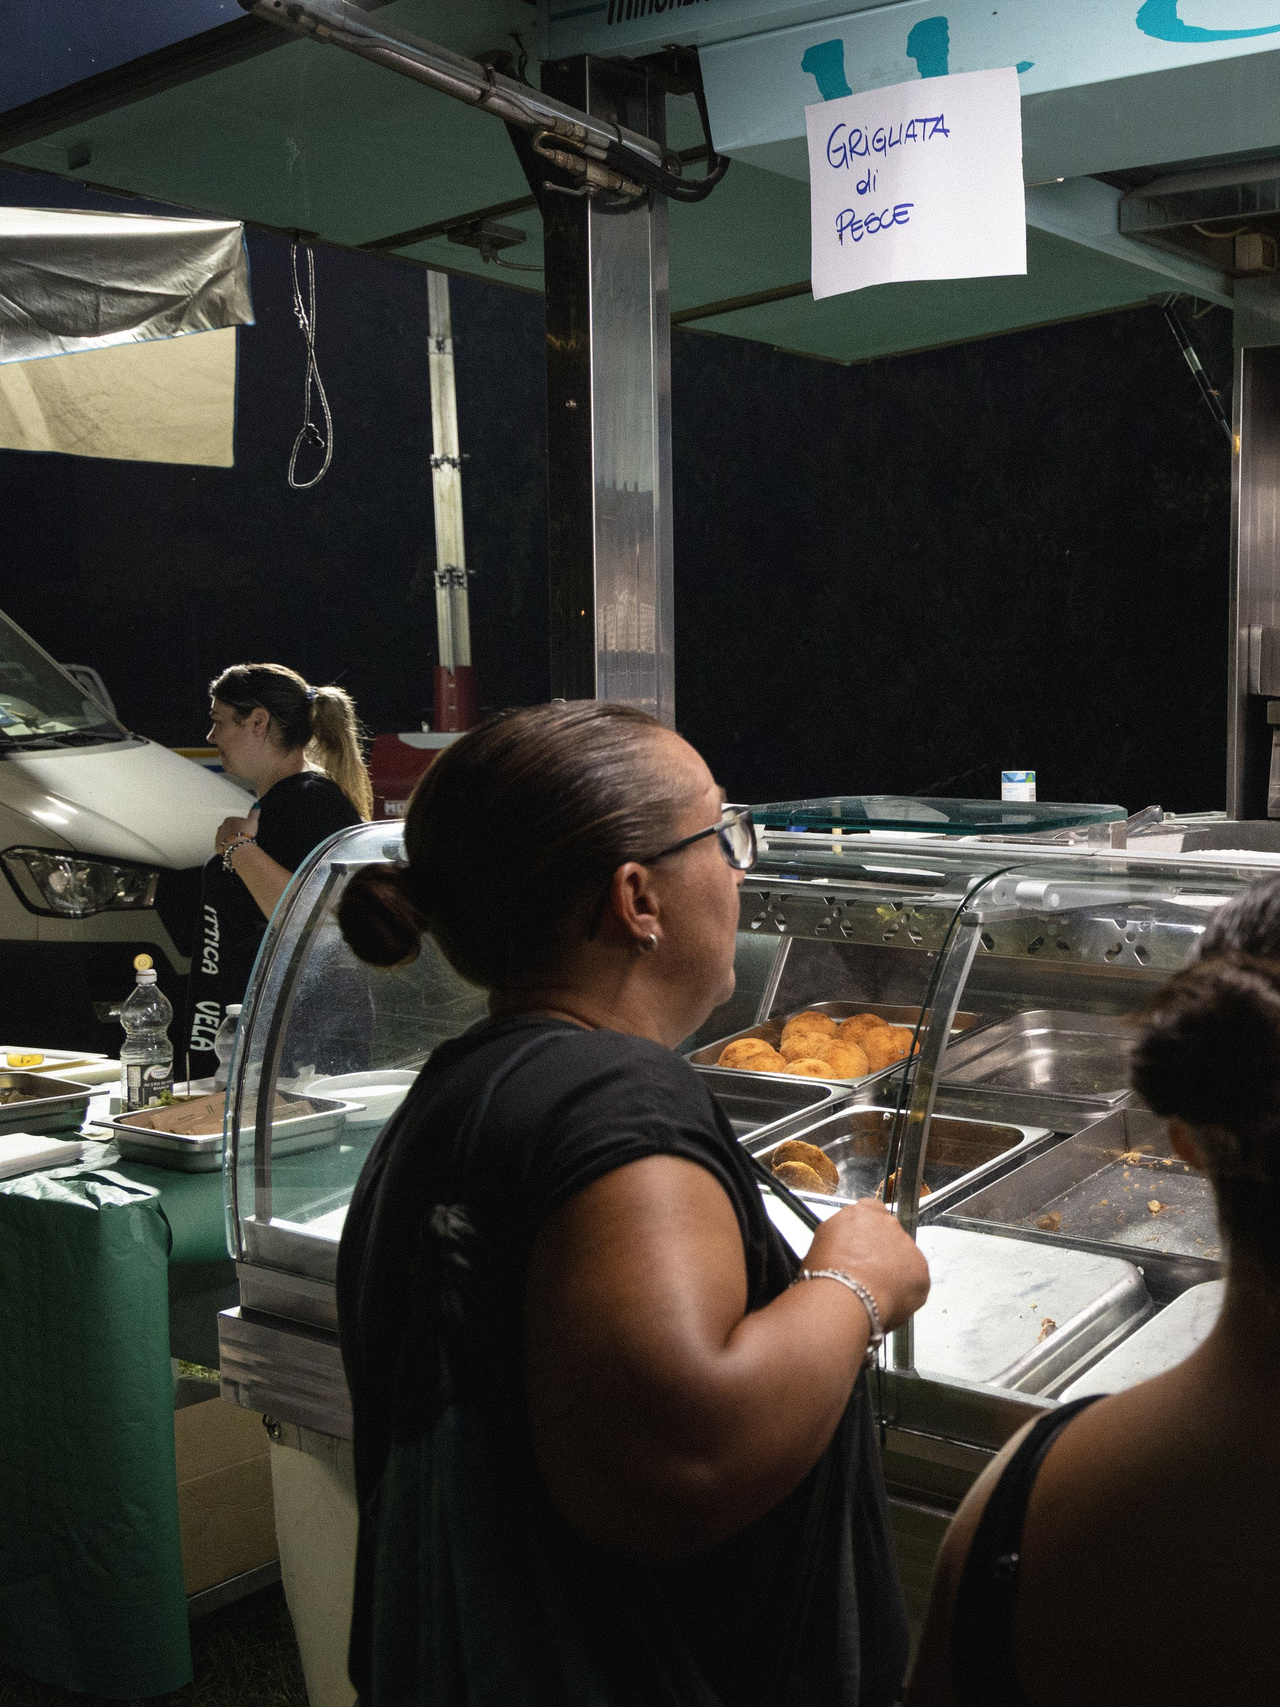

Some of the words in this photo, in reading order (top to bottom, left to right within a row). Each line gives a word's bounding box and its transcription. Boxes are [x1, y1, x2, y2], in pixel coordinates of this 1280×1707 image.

[855, 168, 879, 195] di
[835, 203, 915, 246] PESCE
[201, 904, 220, 975] ITTICA
[190, 1001, 221, 1051] VELA
